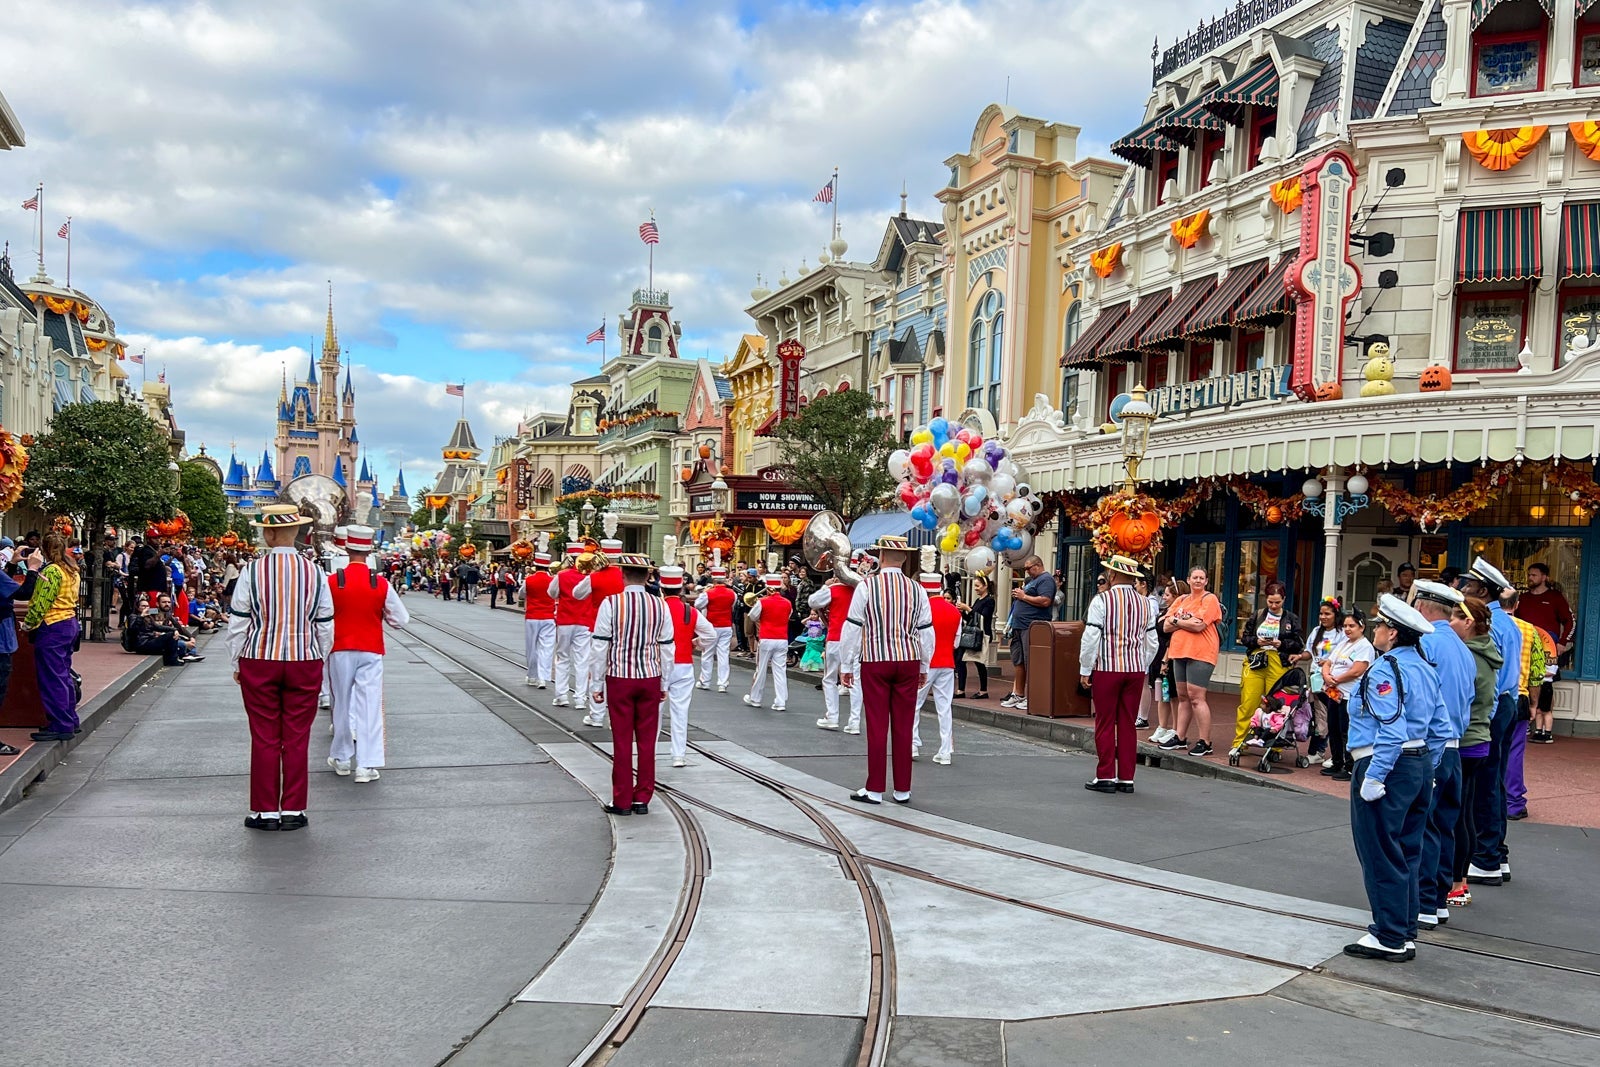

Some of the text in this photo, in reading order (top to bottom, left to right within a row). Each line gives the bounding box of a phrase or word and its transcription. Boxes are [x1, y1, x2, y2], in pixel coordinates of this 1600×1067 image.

[1319, 178, 1341, 383] CONFECTIONERY
[780, 345, 802, 353] MAIN
[785, 359, 798, 418] CINEM
[1146, 364, 1291, 416] ONFECTIONERY
[759, 493, 777, 501] NOW
[760, 502, 786, 510] YEARS
[801, 503, 826, 511] MAGIC
